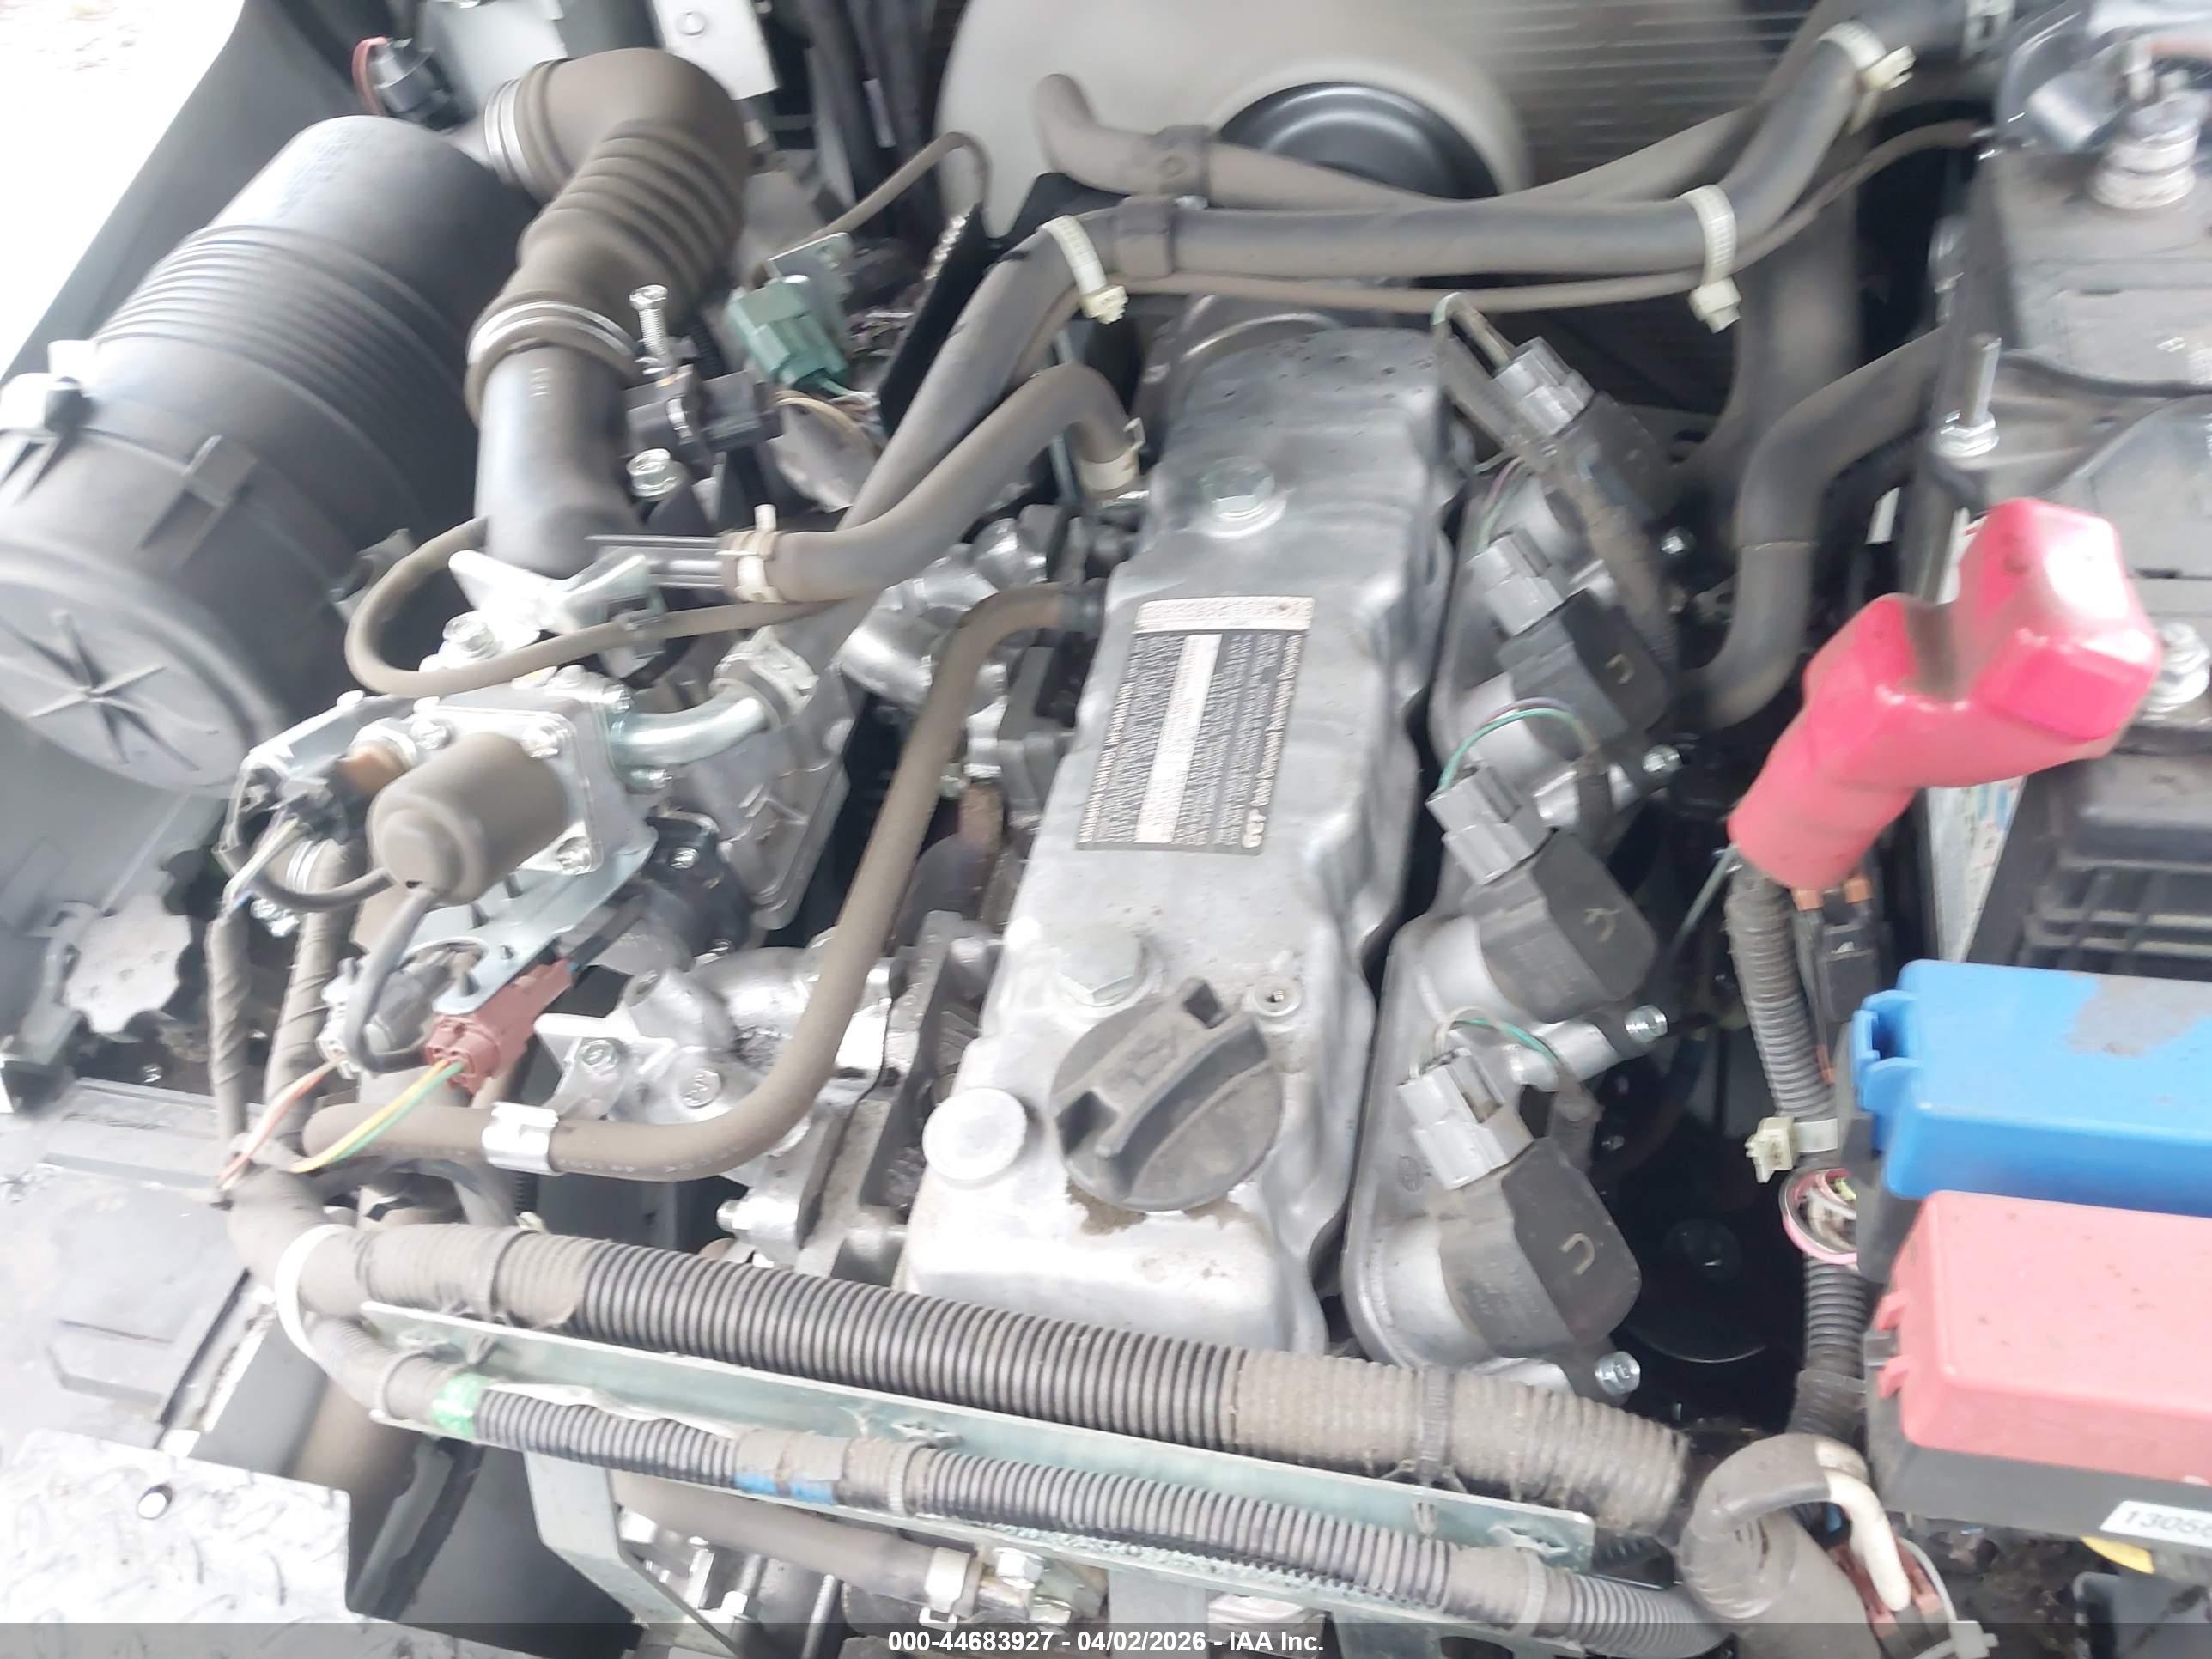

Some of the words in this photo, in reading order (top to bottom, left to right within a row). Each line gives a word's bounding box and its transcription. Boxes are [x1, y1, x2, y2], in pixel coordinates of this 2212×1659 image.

[1105, 682, 1135, 745] INFORMATION
[1095, 746, 1117, 791] CONTROL
[1079, 793, 1103, 842] EMISSION
